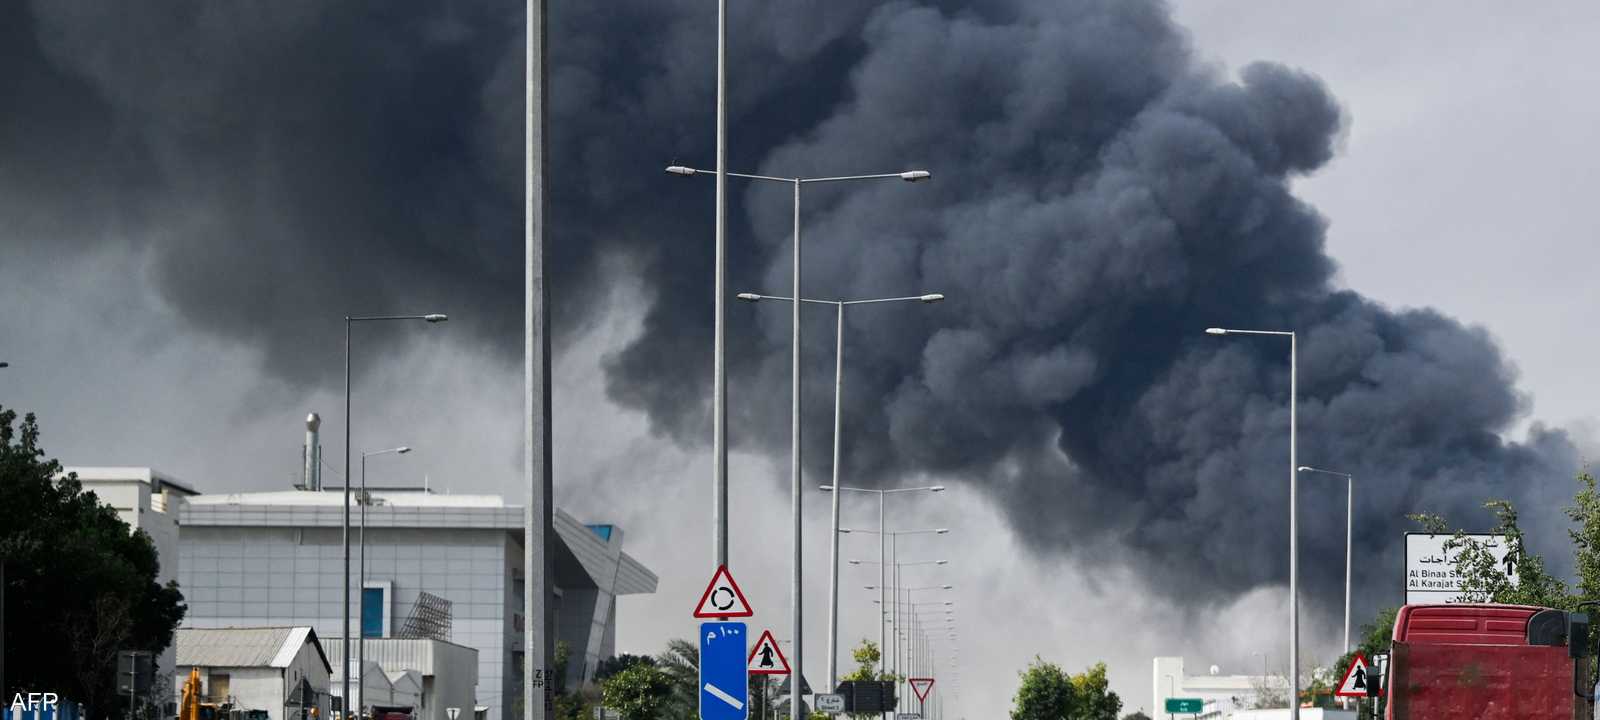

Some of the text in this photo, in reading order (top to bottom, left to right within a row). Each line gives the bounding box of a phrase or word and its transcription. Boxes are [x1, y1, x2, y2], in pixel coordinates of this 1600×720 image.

[1409, 569, 1419, 578] Al
[1421, 569, 1447, 578] Binaa
[1409, 579, 1419, 588] Al
[1421, 579, 1454, 589] Karajat
[706, 625, 740, 646] ١٠٠ م
